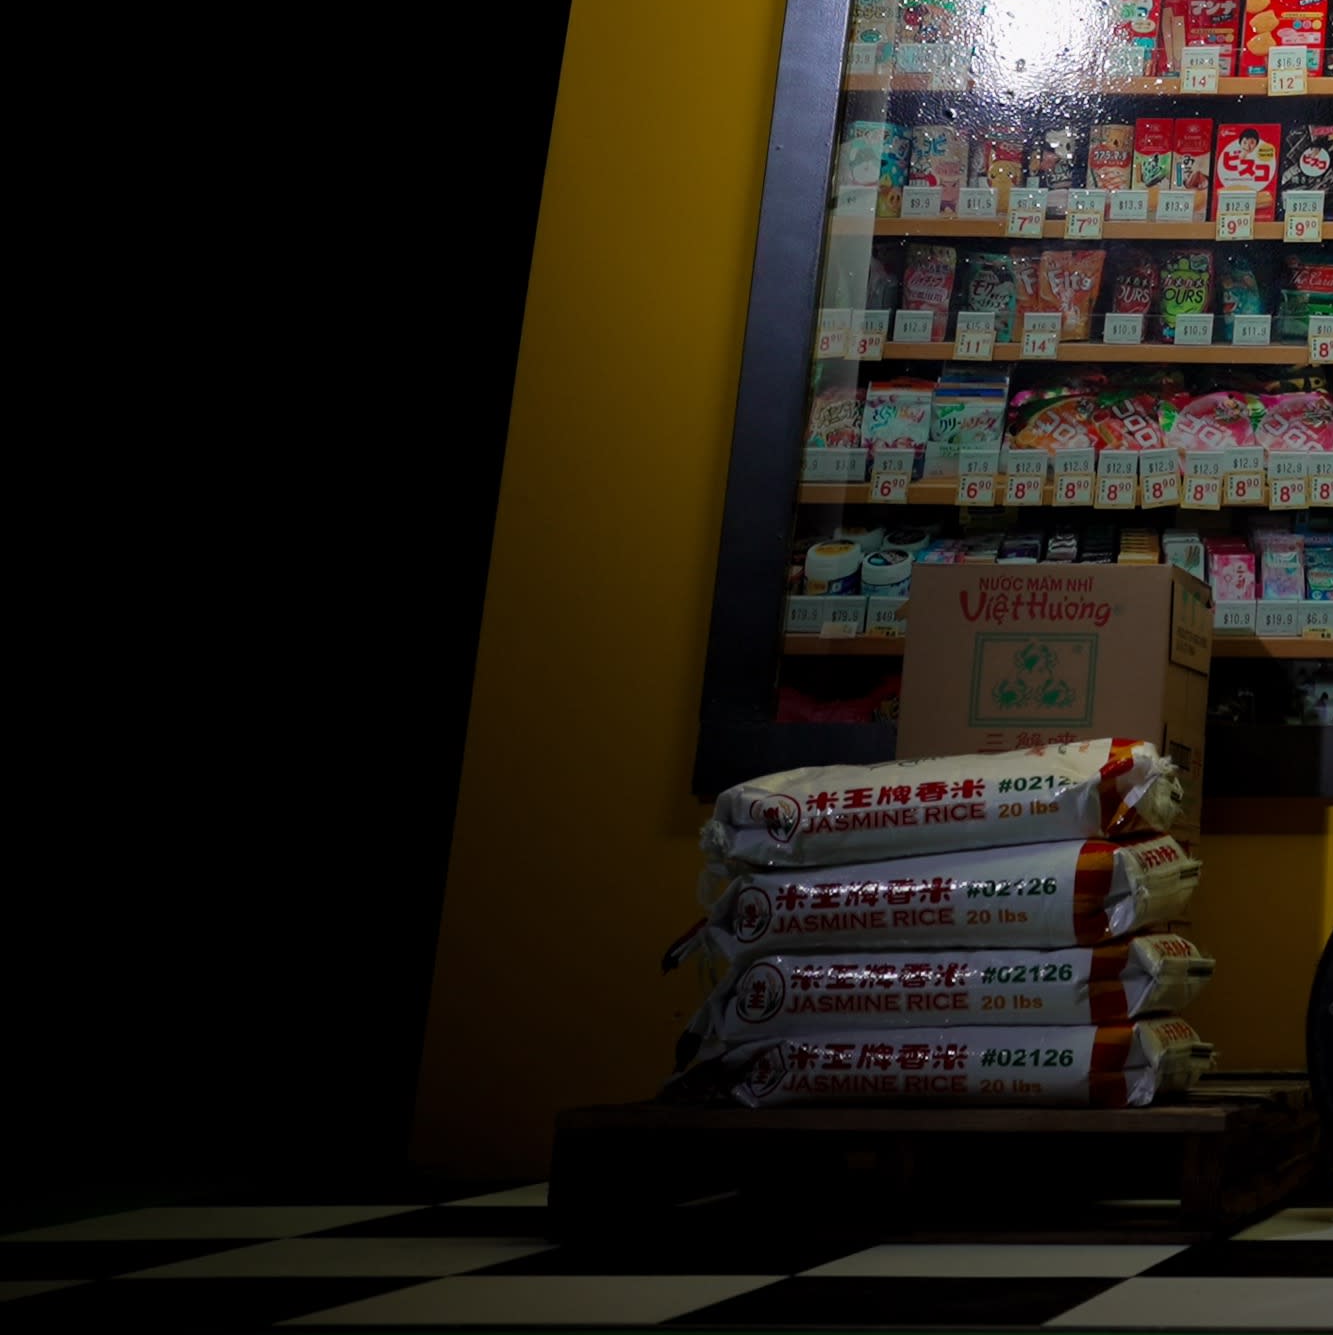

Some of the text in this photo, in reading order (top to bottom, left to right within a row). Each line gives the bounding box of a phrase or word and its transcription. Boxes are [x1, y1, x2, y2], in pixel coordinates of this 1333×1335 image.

[1223, 151, 1270, 182] ビスコ
[801, 800, 986, 835] JASMINE RICE
[998, 799, 1059, 818] 20 lbs
[966, 877, 1057, 899] #02126
[773, 908, 955, 935] JASMINE RICE
[966, 908, 1028, 926] 20 lbs
[981, 964, 1073, 984] #02126
[786, 992, 969, 1014] JASMINE RICE
[981, 994, 1043, 1010] 20 lbs
[981, 1048, 1074, 1068] #02126
[783, 1074, 968, 1094] JASMINE RICE
[980, 1079, 1042, 1095] 20 lbs
